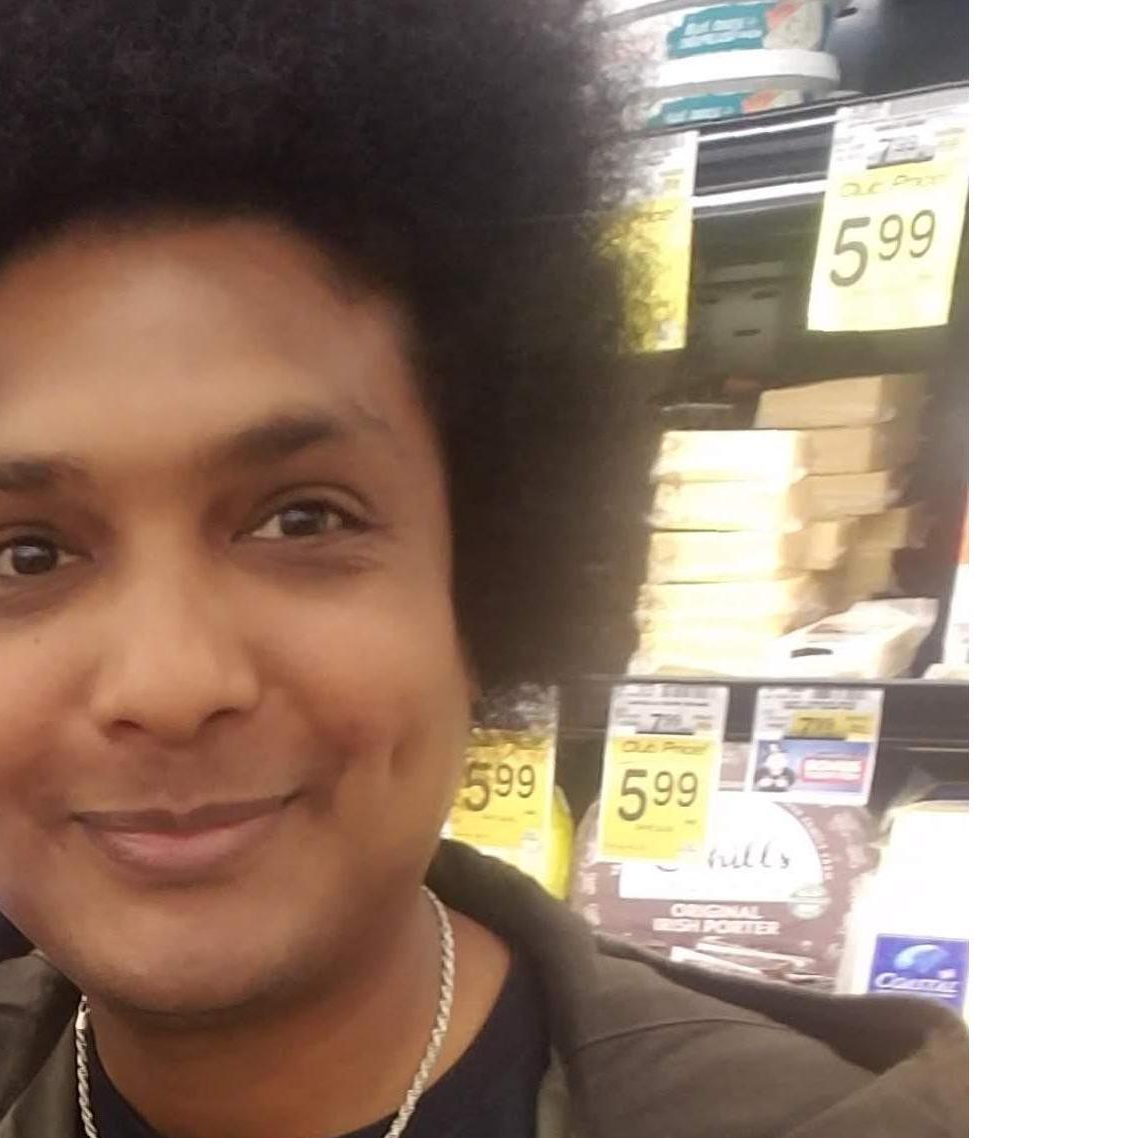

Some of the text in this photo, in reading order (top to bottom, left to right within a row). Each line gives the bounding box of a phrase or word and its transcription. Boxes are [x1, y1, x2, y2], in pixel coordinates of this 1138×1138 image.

[618, 768, 698, 822] 599
[669, 903, 763, 919] ORIGINAL
[702, 919, 781, 935] PORTER
